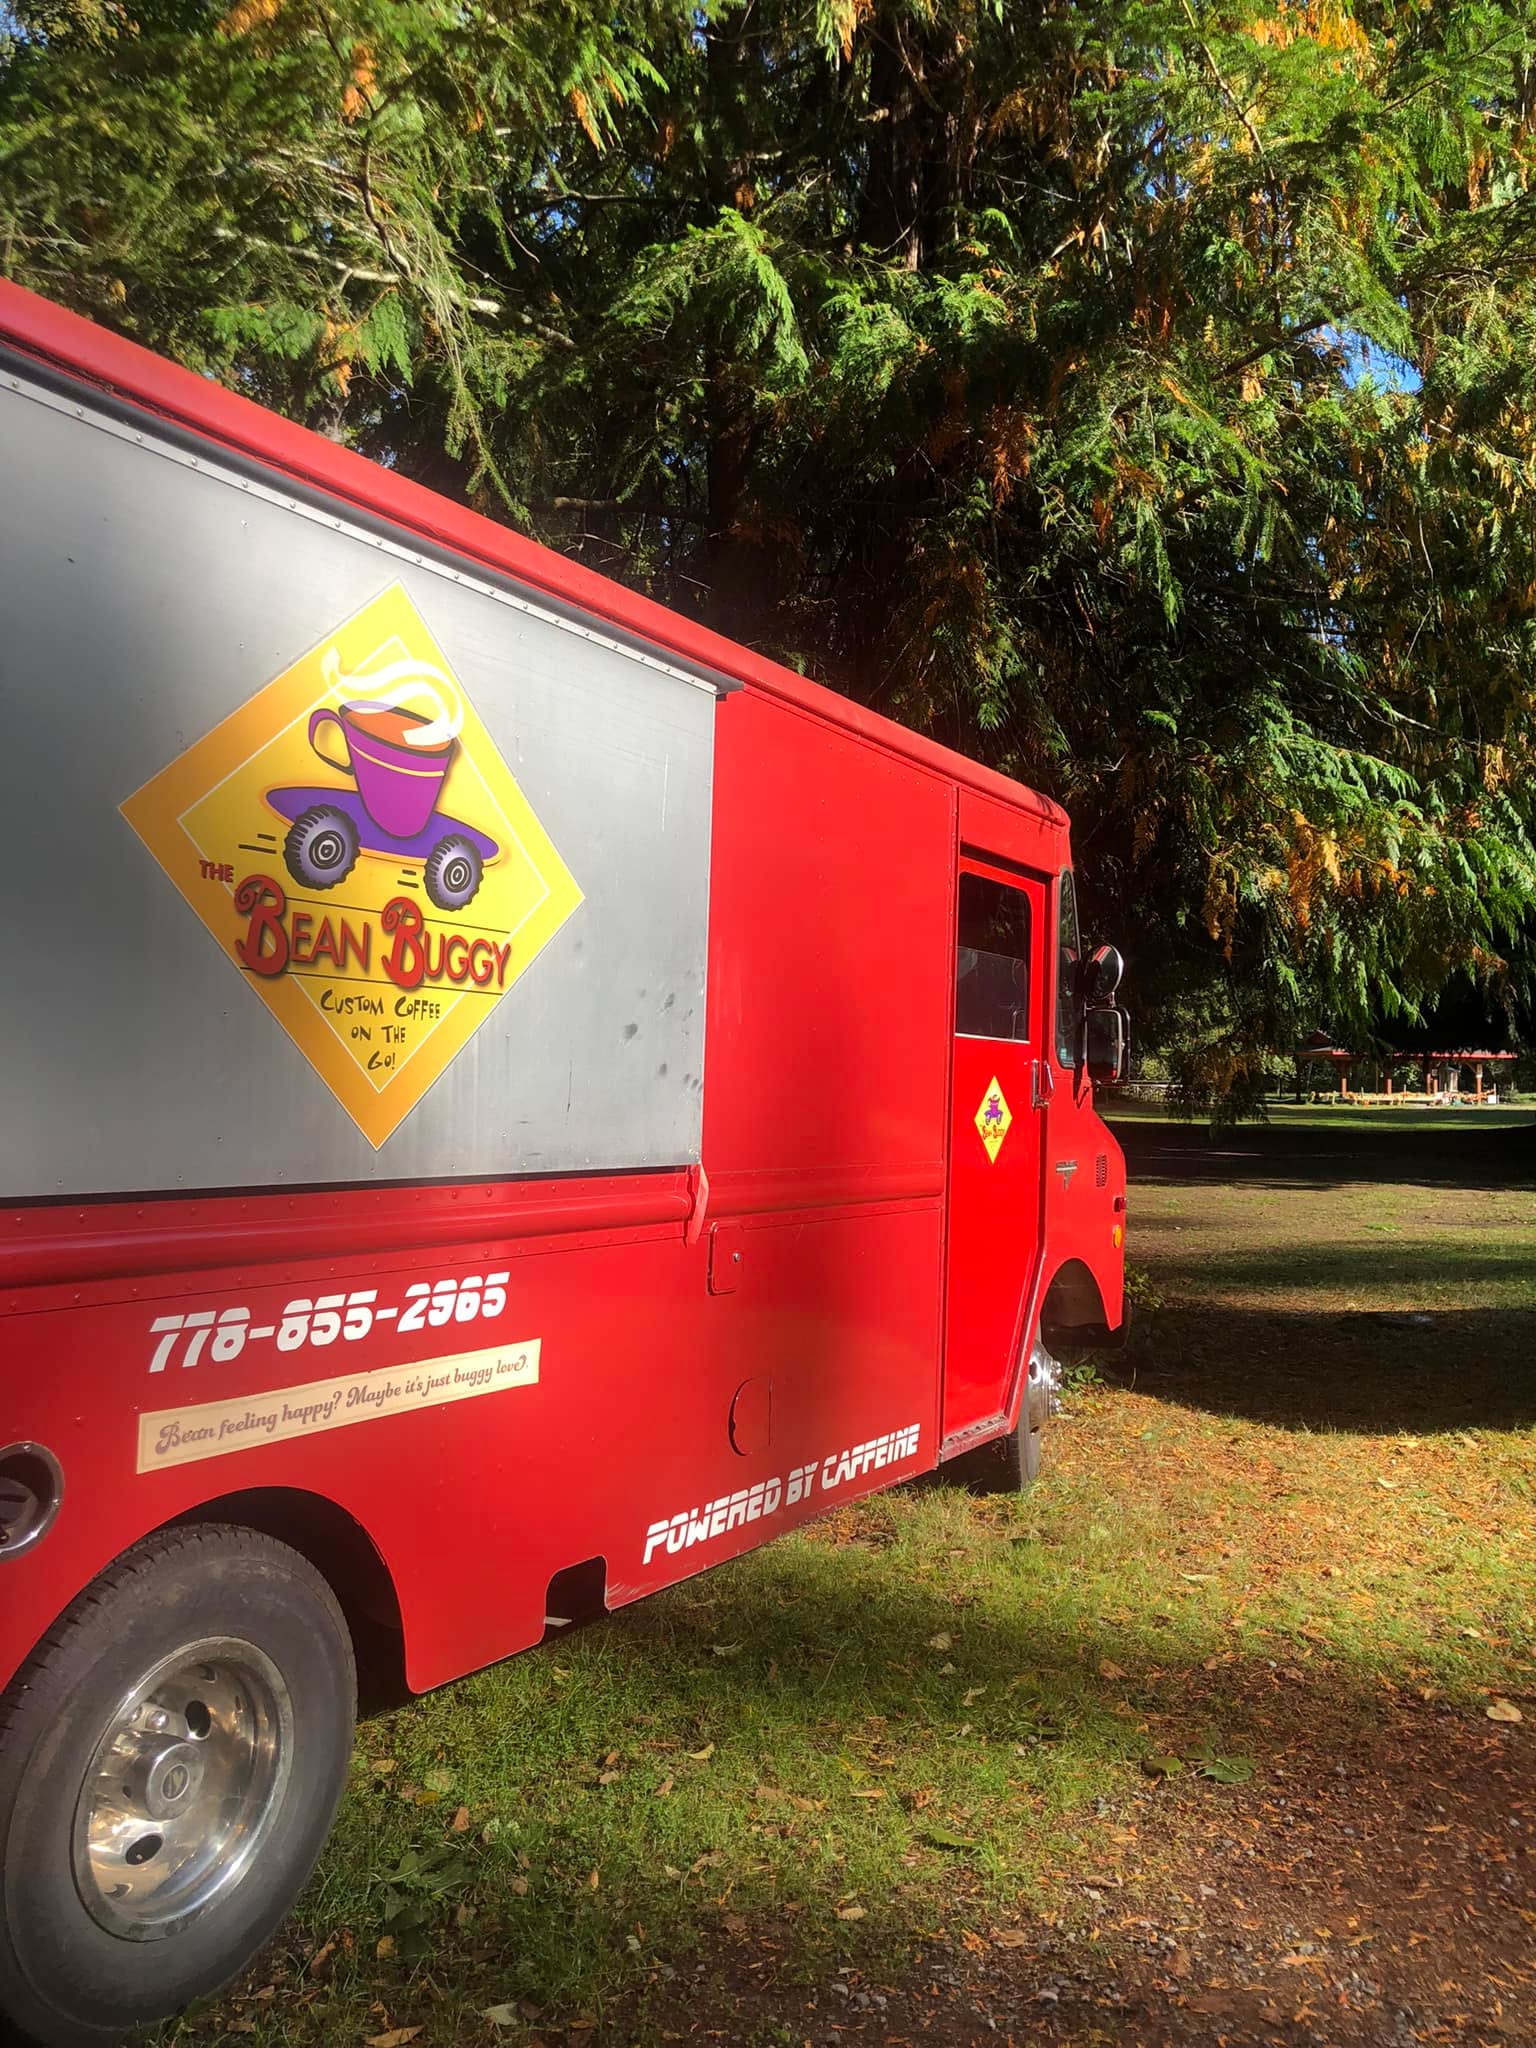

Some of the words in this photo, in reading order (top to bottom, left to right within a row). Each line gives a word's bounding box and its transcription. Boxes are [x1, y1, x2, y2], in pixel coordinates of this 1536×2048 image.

[199, 859, 234, 883] THE
[234, 874, 370, 976] BEAN
[381, 896, 512, 988] BUGGY
[320, 989, 384, 1016] CUSTOM
[394, 996, 440, 1020] COFFEE
[351, 1025, 371, 1040] ON
[381, 1025, 406, 1043] THE
[367, 1051, 396, 1070] GO!
[148, 1271, 511, 1373] 778-855-2965
[155, 1421, 215, 1455] Bean
[218, 1412, 278, 1440] feeling
[281, 1391, 342, 1424] happy?
[346, 1382, 401, 1408] Maybe
[405, 1376, 423, 1394] it's
[422, 1374, 451, 1397] just
[453, 1367, 494, 1388] buggy
[642, 1477, 781, 1565] POWERED
[786, 1461, 818, 1505] BY
[821, 1423, 920, 1490] CAFFEINE
